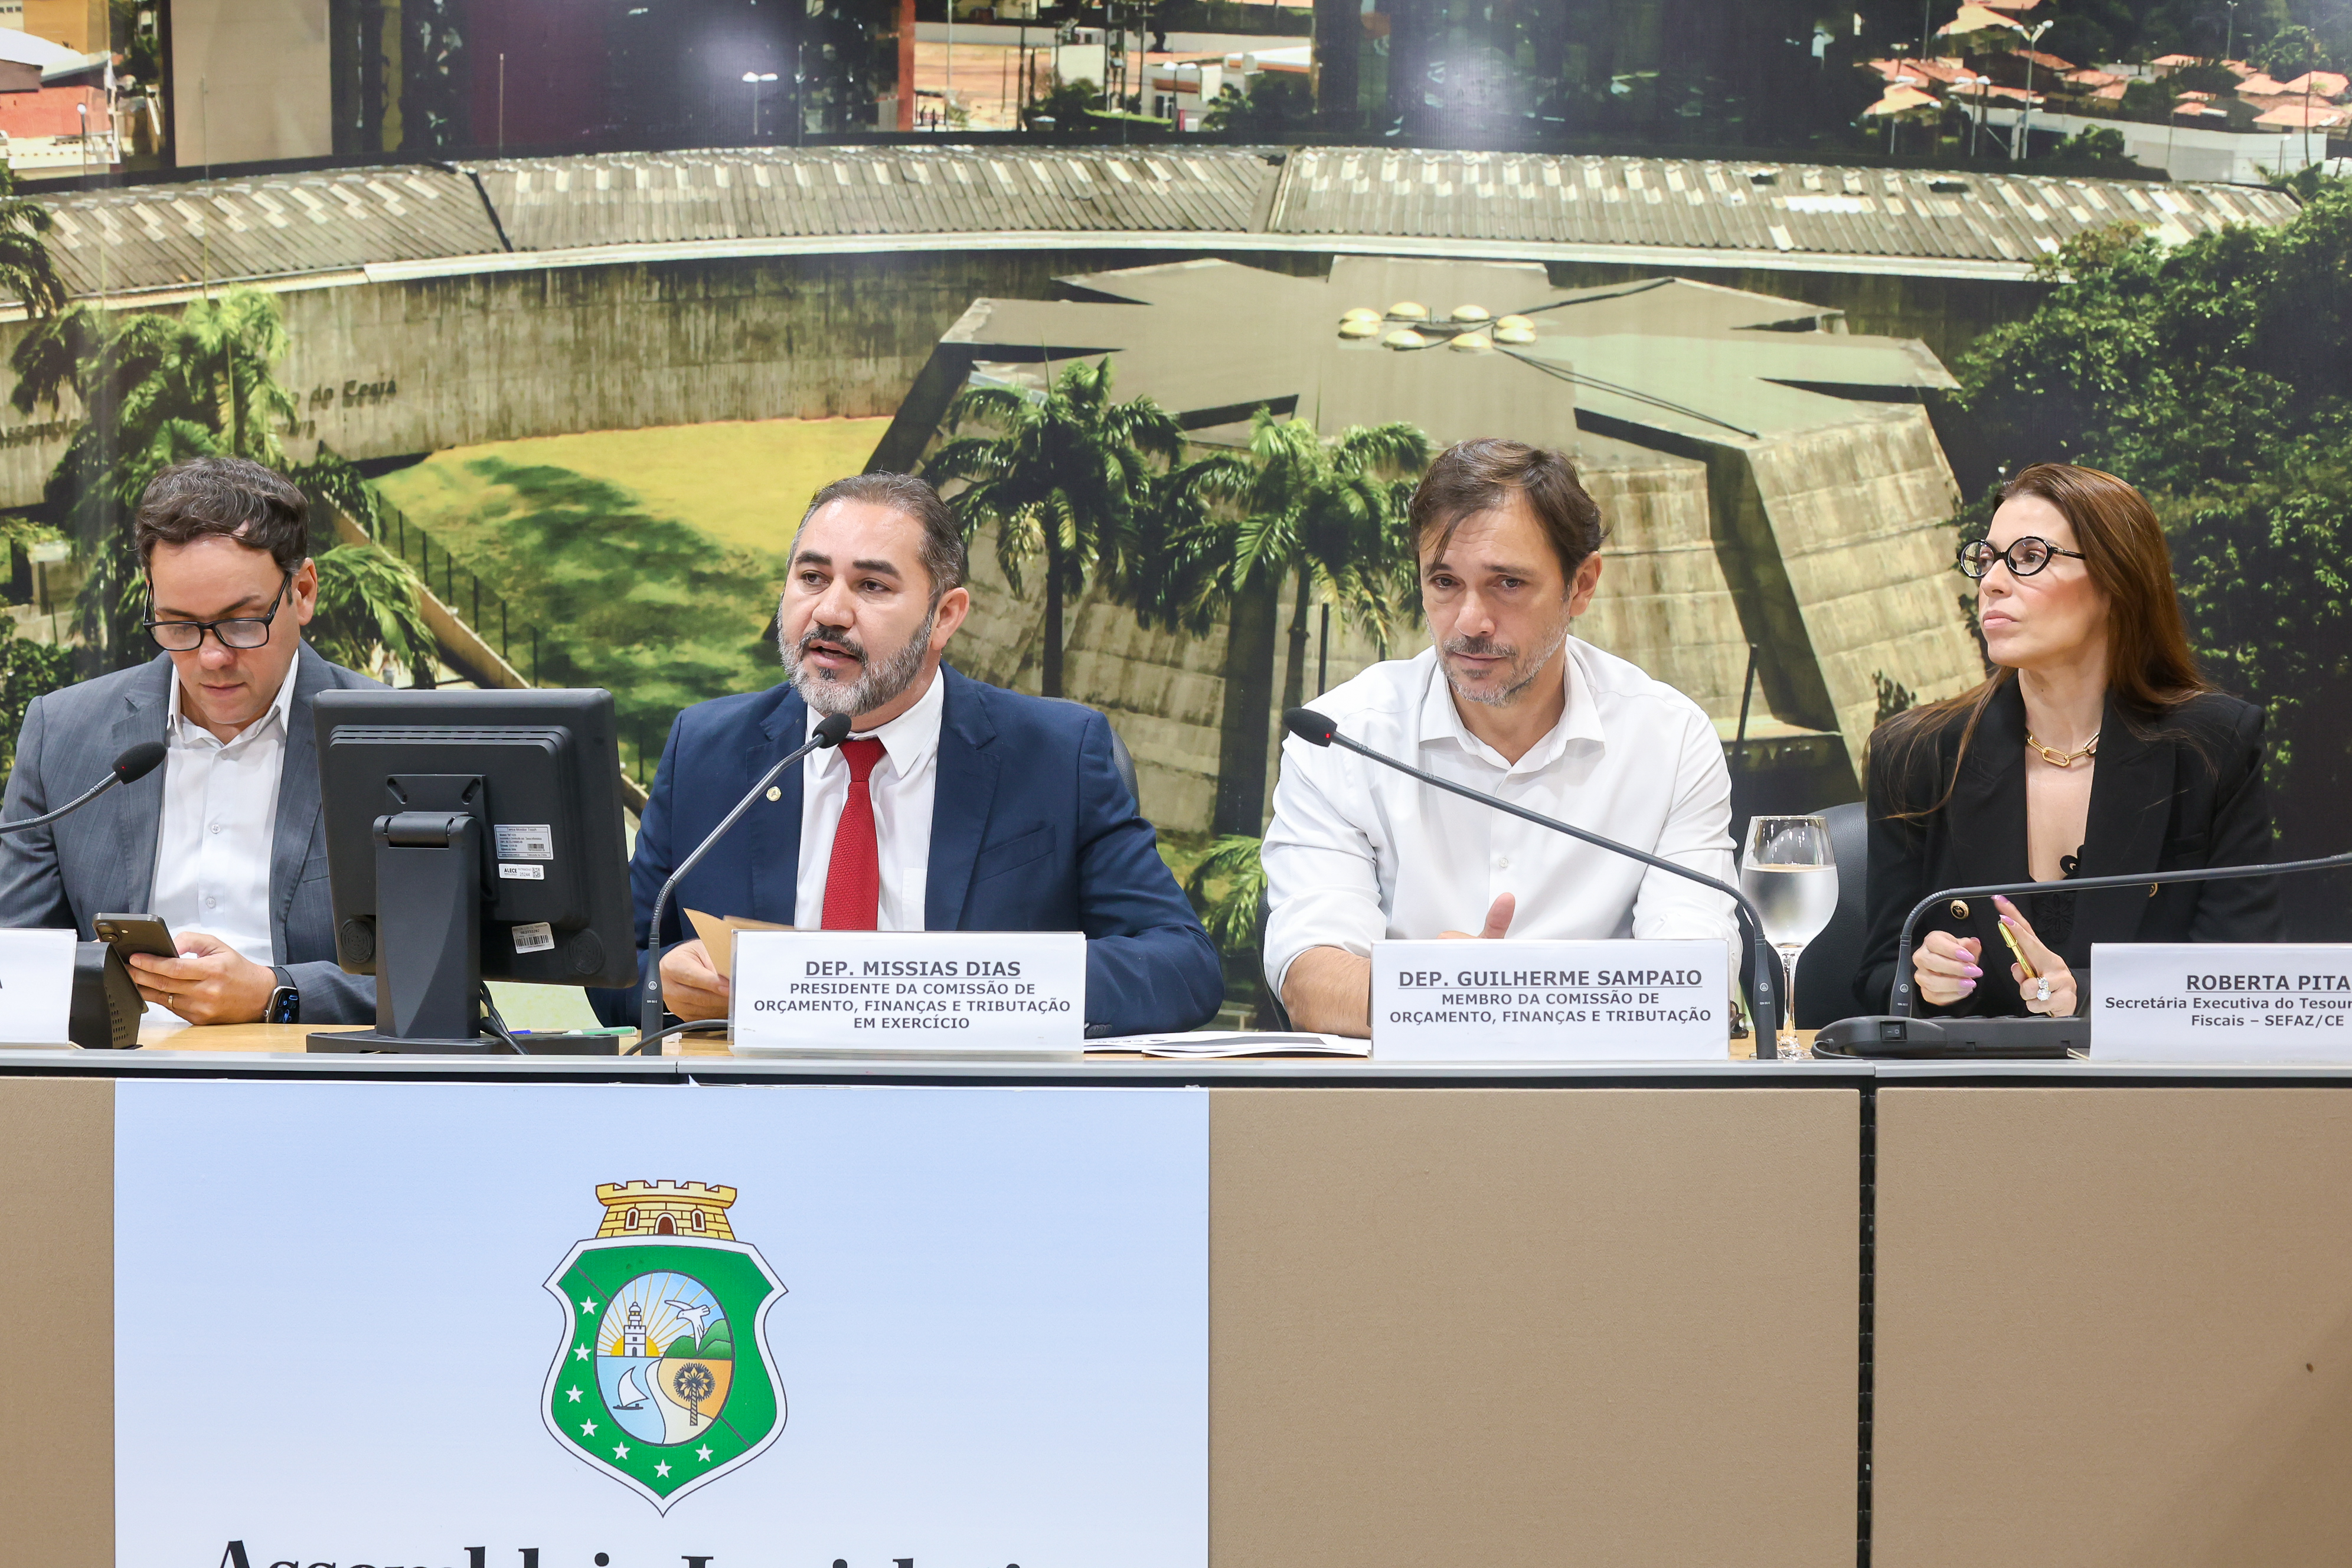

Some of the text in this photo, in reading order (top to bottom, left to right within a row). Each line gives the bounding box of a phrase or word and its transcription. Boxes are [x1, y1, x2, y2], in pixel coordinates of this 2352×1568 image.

[805, 961, 1021, 976] DEP. MISSIAS DIAS
[1399, 970, 1702, 986] DEP. GUILHERME SAMPAIO
[2187, 975, 2351, 991] ROBERTA PITA
[790, 981, 1035, 994] PRESIDENTE DA COMISSÃO DE
[1442, 990, 1659, 1005] MEMBRO DA COMISSÃO DE
[2105, 996, 2187, 1009] Secretária
[2193, 997, 2269, 1009] Executiva
[2275, 997, 2294, 1009] do
[754, 998, 1070, 1015] ORÇAMENTO, FINANÇAS E TRIBUTAÇÃO
[854, 1013, 970, 1029] EM EXERCÍCIO
[1390, 1007, 1711, 1024] ORÇAMENTO, FINANÇAS E TRIBUTAÇÃO
[2191, 1014, 2244, 1026] Fiscais
[2265, 1014, 2344, 1028] SEFAZ/CE
